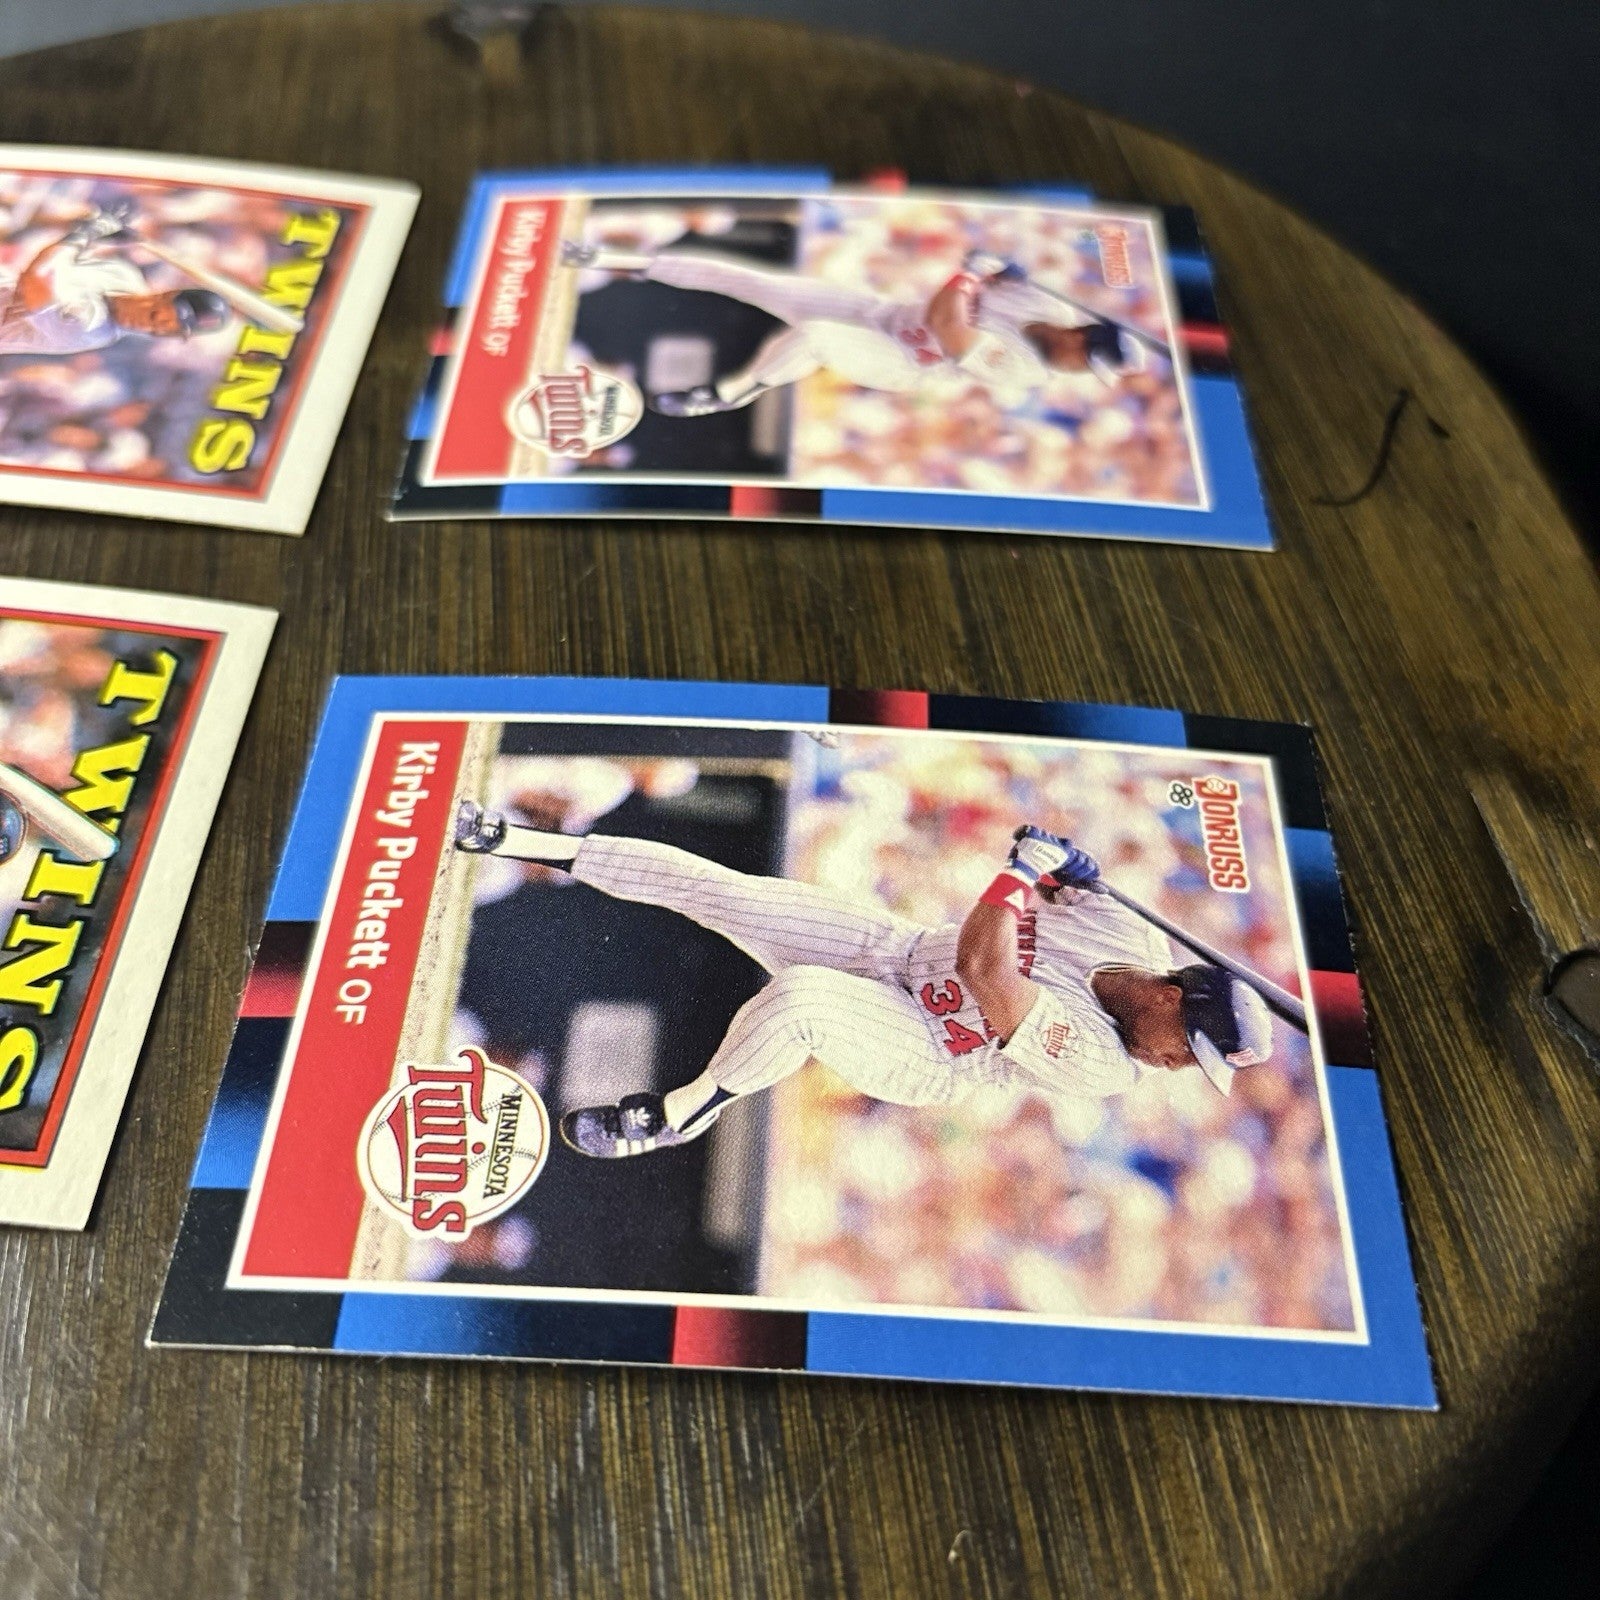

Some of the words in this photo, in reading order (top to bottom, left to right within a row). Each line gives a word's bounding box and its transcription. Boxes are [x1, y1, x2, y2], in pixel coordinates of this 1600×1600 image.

[500, 208, 549, 257] Kirby
[190, 207, 342, 475] TWINS
[488, 257, 538, 329] Puckett
[375, 741, 441, 829] Kirby
[1193, 778, 1248, 890] DONRUSS
[346, 836, 419, 970] Puckett
[335, 978, 373, 1026] OF
[920, 977, 989, 1059] 34
[407, 1049, 488, 1233] Twins
[482, 1092, 523, 1200] MINNESOTA
